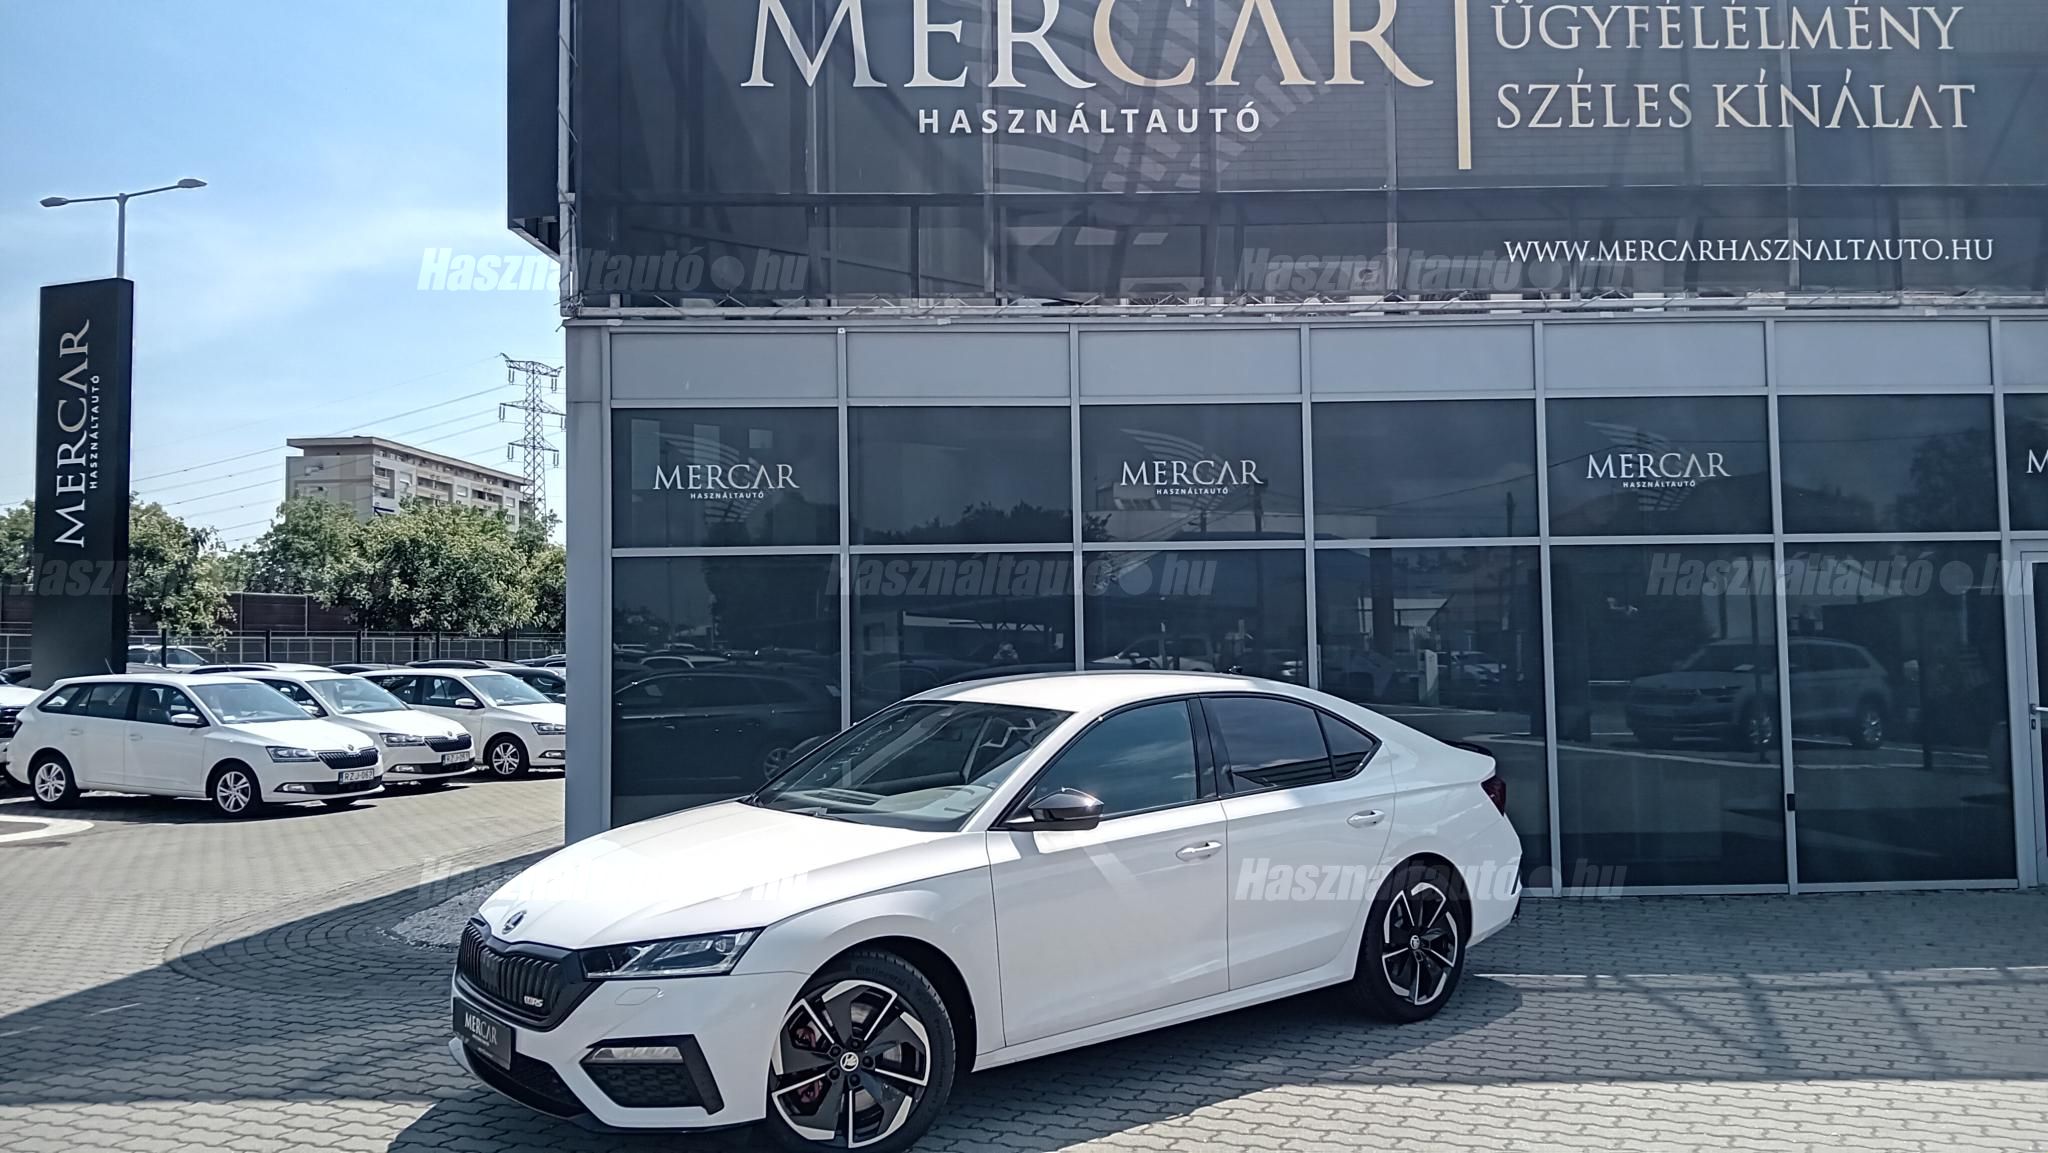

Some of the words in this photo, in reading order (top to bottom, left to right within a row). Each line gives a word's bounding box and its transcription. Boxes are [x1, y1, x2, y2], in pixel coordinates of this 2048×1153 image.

[1493, 0, 1964, 51] ÜGYFÉLÉLMÉNY
[741, 0, 1434, 89] MERCAR
[1496, 68, 1693, 129] SZÉLES
[1712, 68, 1976, 129] KÍNÁLAT
[917, 102, 1261, 135] HASZNÁLTAUTÓ
[1503, 238, 1994, 263] WWW.MERCARHASZNALTAUTO.HU
[55, 319, 90, 548] MERCAR
[89, 375, 100, 489] HASZNÁLTAUTÓ
[652, 464, 801, 490] MERCAR
[1120, 460, 1265, 486] MERCAR
[1586, 453, 1733, 479] MERCAR
[690, 491, 765, 500] HASZNÁLTAUTÓ
[1156, 487, 1229, 495] HASZNÁLTAUTÓ
[1622, 480, 1696, 488] HASZNÁLTAUTÓ
[464, 1012, 498, 1046] MERCAR
